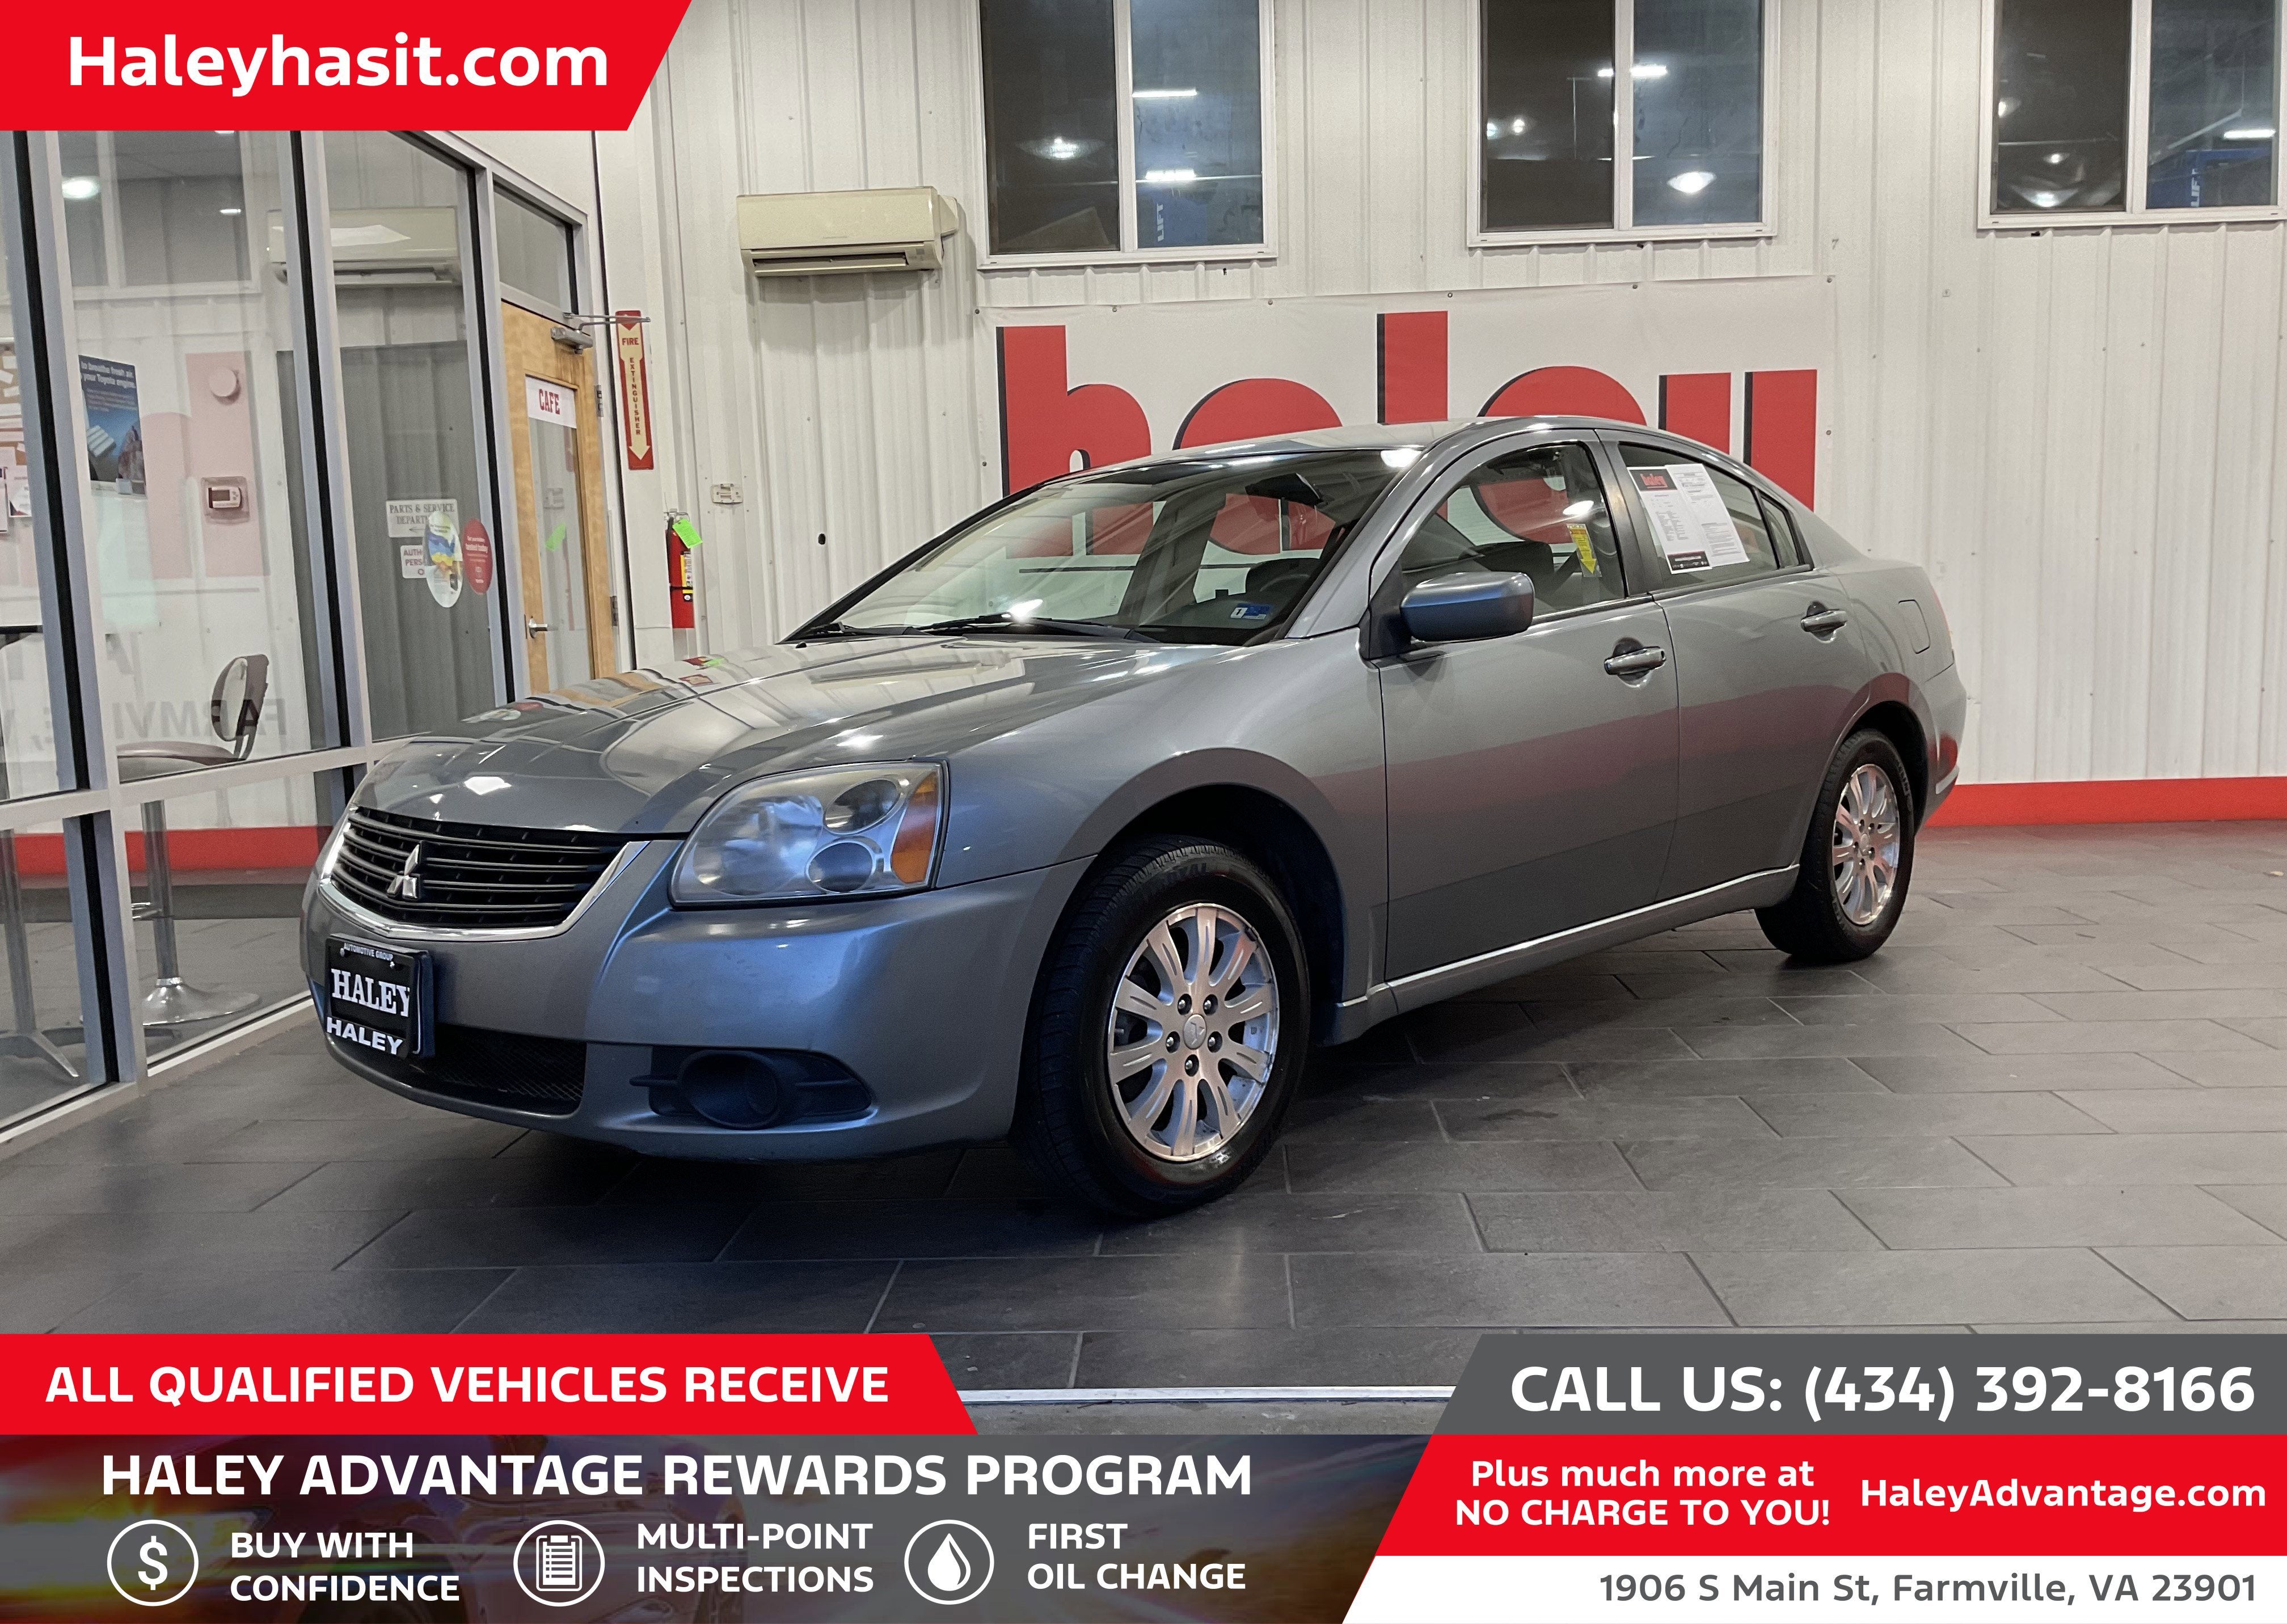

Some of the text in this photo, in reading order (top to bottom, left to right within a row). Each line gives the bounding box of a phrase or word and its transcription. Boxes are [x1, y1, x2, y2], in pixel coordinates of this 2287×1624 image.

[622, 337, 639, 346] FIRE
[539, 388, 560, 415] CAFE
[630, 357, 641, 435] EXTINGUISHER
[389, 504, 413, 514] PARTS
[423, 503, 455, 513] SERVICE
[344, 942, 394, 961] AUTOMOTIVE GROUP
[331, 968, 410, 1017] HALEY
[326, 1016, 403, 1055] HALEY
